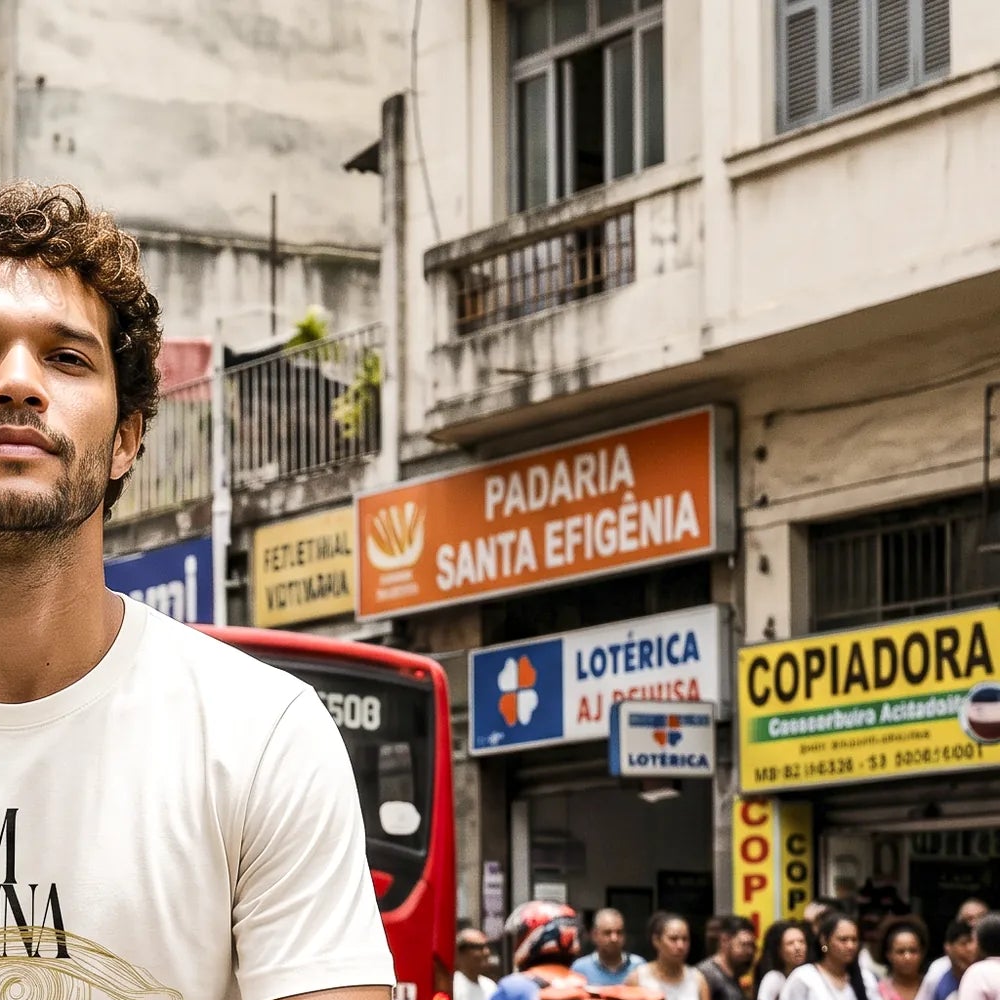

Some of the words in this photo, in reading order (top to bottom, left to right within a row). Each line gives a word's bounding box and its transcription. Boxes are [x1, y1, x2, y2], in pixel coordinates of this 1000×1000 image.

[485, 445, 635, 522] PADARIA
[435, 528, 538, 591] SANTA
[545, 491, 700, 569] EFIGÊNIA
[576, 630, 701, 681] LOTÉRICA
[747, 621, 995, 707] COPIADORA
[318, 691, 381, 731] 508
